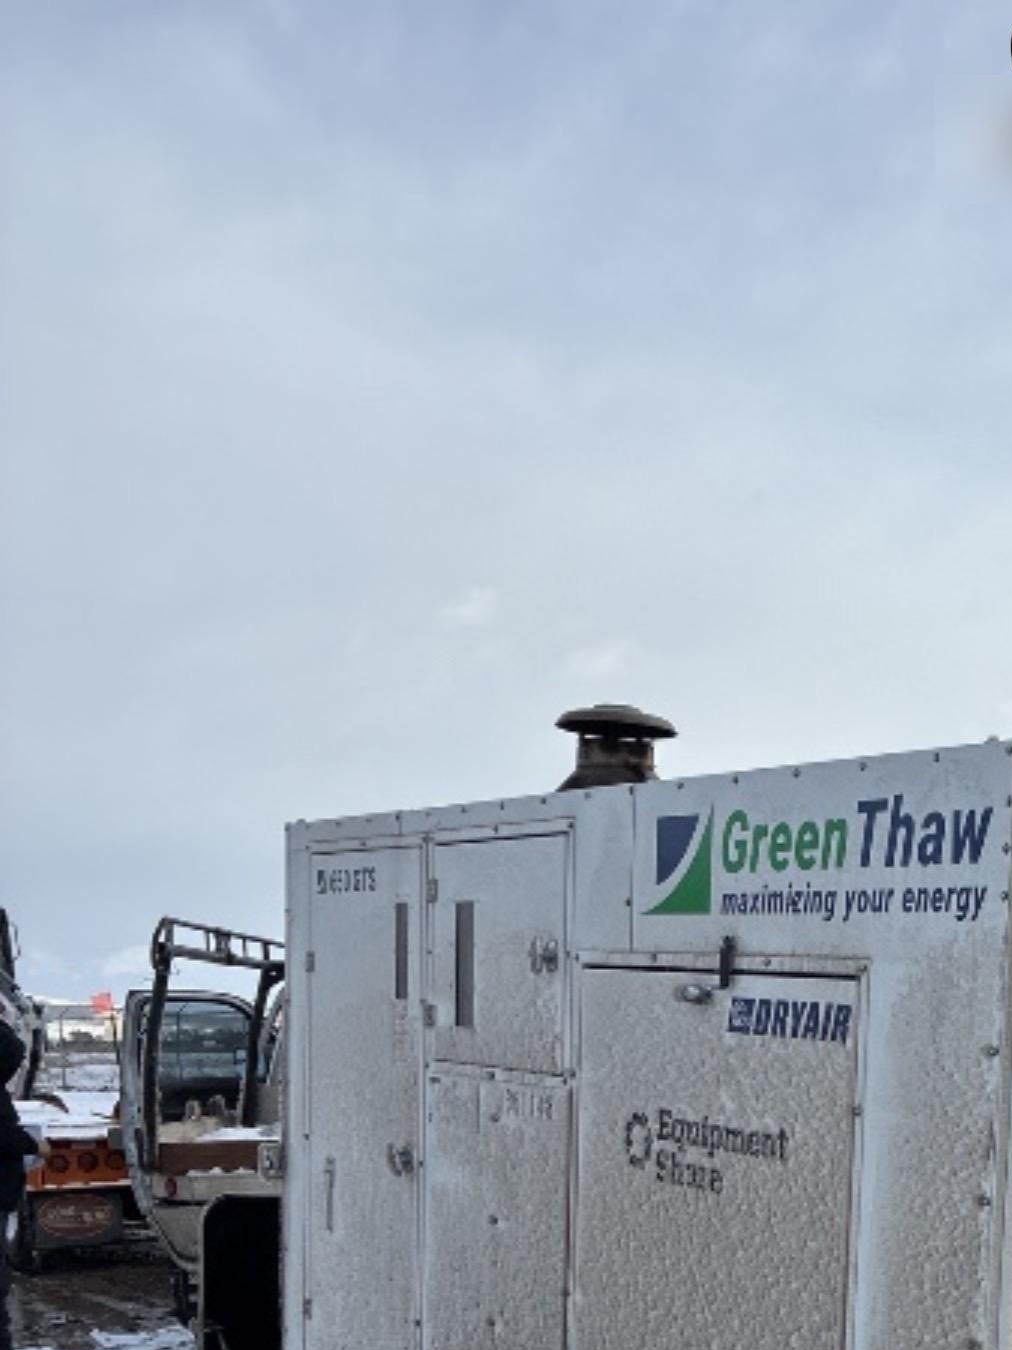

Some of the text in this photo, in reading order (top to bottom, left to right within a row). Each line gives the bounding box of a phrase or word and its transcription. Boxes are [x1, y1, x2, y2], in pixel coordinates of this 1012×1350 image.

[720, 882, 988, 922] maximizing your energy
[751, 998, 853, 1044] DRYAIR
[657, 1108, 788, 1159] Equipment
[657, 1149, 724, 1195] Share
